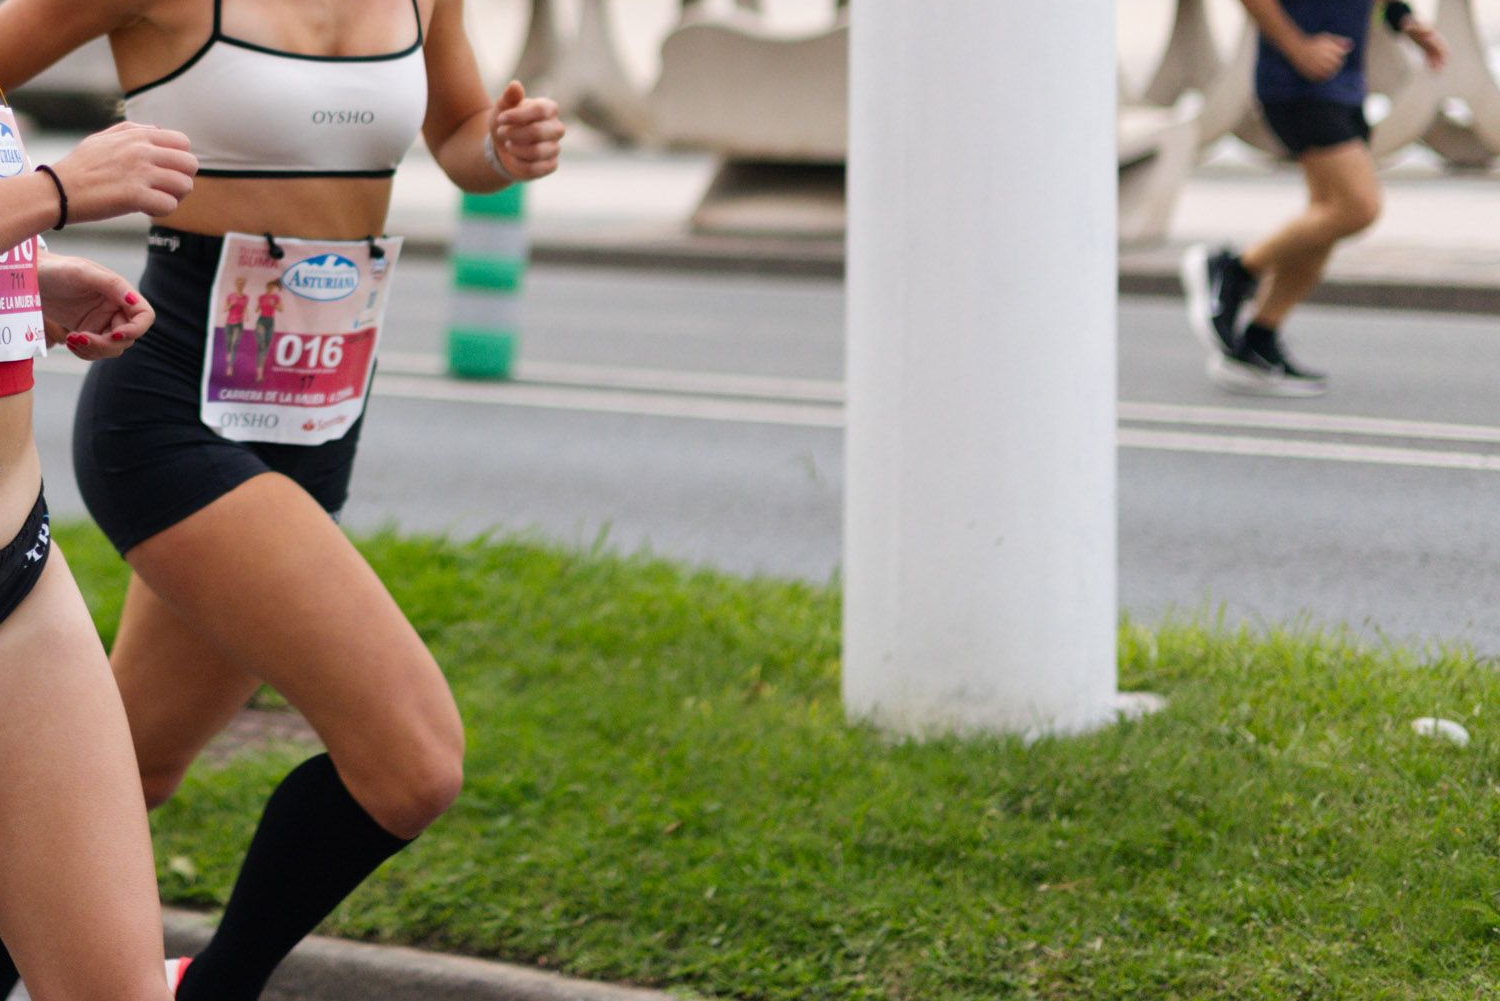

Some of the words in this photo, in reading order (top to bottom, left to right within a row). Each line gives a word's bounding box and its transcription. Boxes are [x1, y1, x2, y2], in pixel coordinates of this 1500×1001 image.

[311, 110, 375, 125] OYSHO
[289, 270, 356, 289] ASTURIANA
[6, 295, 14, 310] LA
[274, 334, 345, 368] 016
[219, 388, 262, 401] CARRERA
[265, 390, 278, 401] DE
[279, 391, 293, 403] LA
[220, 411, 279, 429] OYSHO
